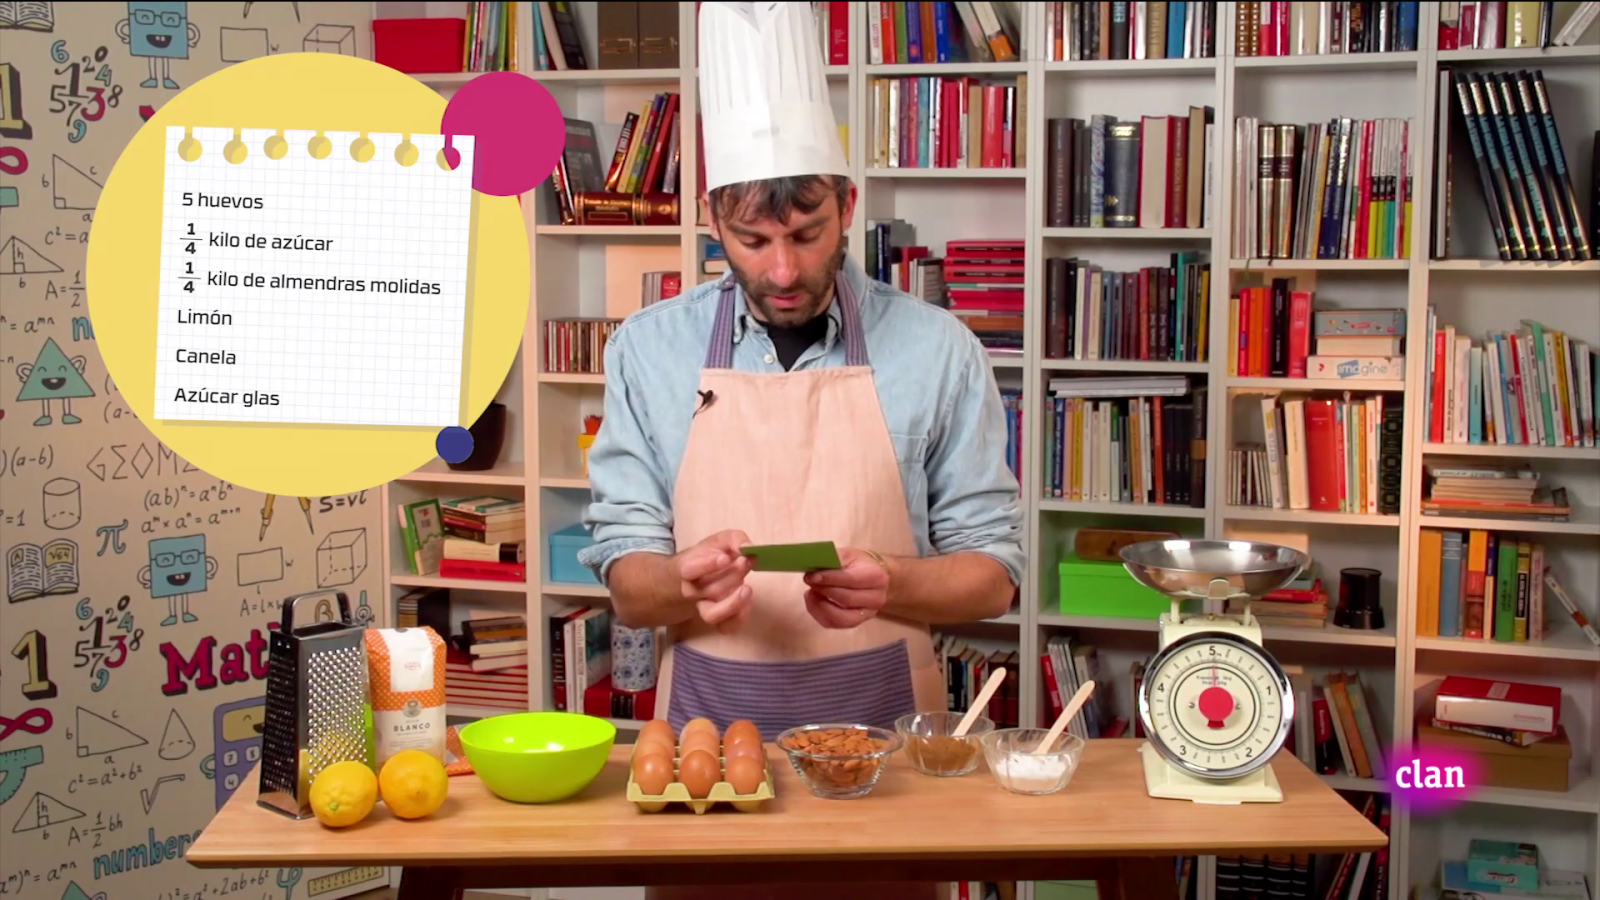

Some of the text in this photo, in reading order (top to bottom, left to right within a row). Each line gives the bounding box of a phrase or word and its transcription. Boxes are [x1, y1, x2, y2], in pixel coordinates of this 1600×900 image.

[1209, 646, 1216, 656] 5
[1157, 683, 1165, 692] 4
[1266, 686, 1271, 695] 1
[393, 722, 431, 732] BLANCO
[1180, 745, 1187, 755] 3
[1245, 747, 1253, 757] 2
